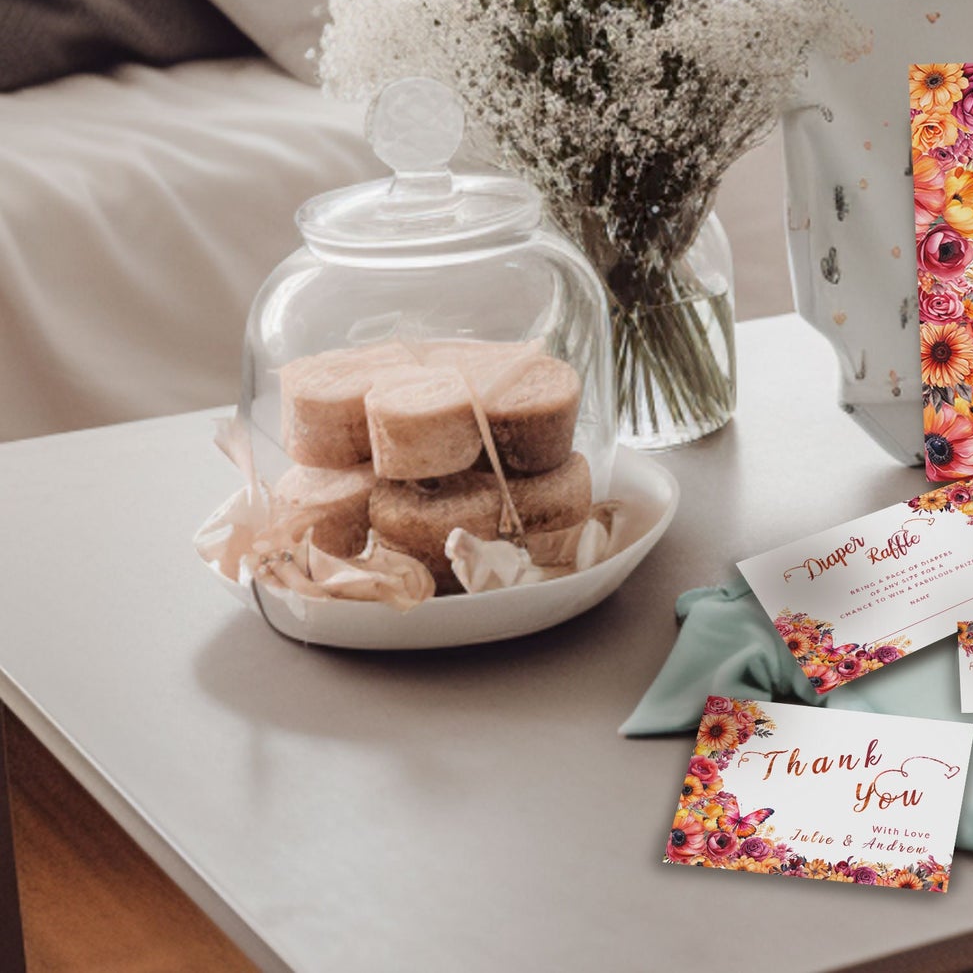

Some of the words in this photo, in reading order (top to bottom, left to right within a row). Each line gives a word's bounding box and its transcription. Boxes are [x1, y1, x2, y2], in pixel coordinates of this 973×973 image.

[789, 535, 865, 582] Diaper
[865, 525, 926, 565] Raffle
[850, 582, 876, 596] BRING
[885, 569, 906, 581] PACK
[908, 564, 918, 572] OF
[920, 550, 953, 567] DIAPERS
[870, 589, 881, 597] OF
[883, 581, 899, 592] ANY
[901, 573, 918, 584] SIZE
[920, 567, 936, 576] FOR
[840, 602, 873, 620] CHANCE
[875, 597, 886, 605] TO
[888, 588, 905, 599] WIN
[914, 569, 953, 588] FABULOUS
[910, 593, 931, 606] NAME
[742, 738, 884, 781] Thank
[853, 769, 935, 813] You
[789, 829, 834, 845] Julie
[842, 834, 854, 846] &
[862, 838, 929, 855] Andrew
[872, 825, 900, 837] With
[904, 827, 931, 839] Love
